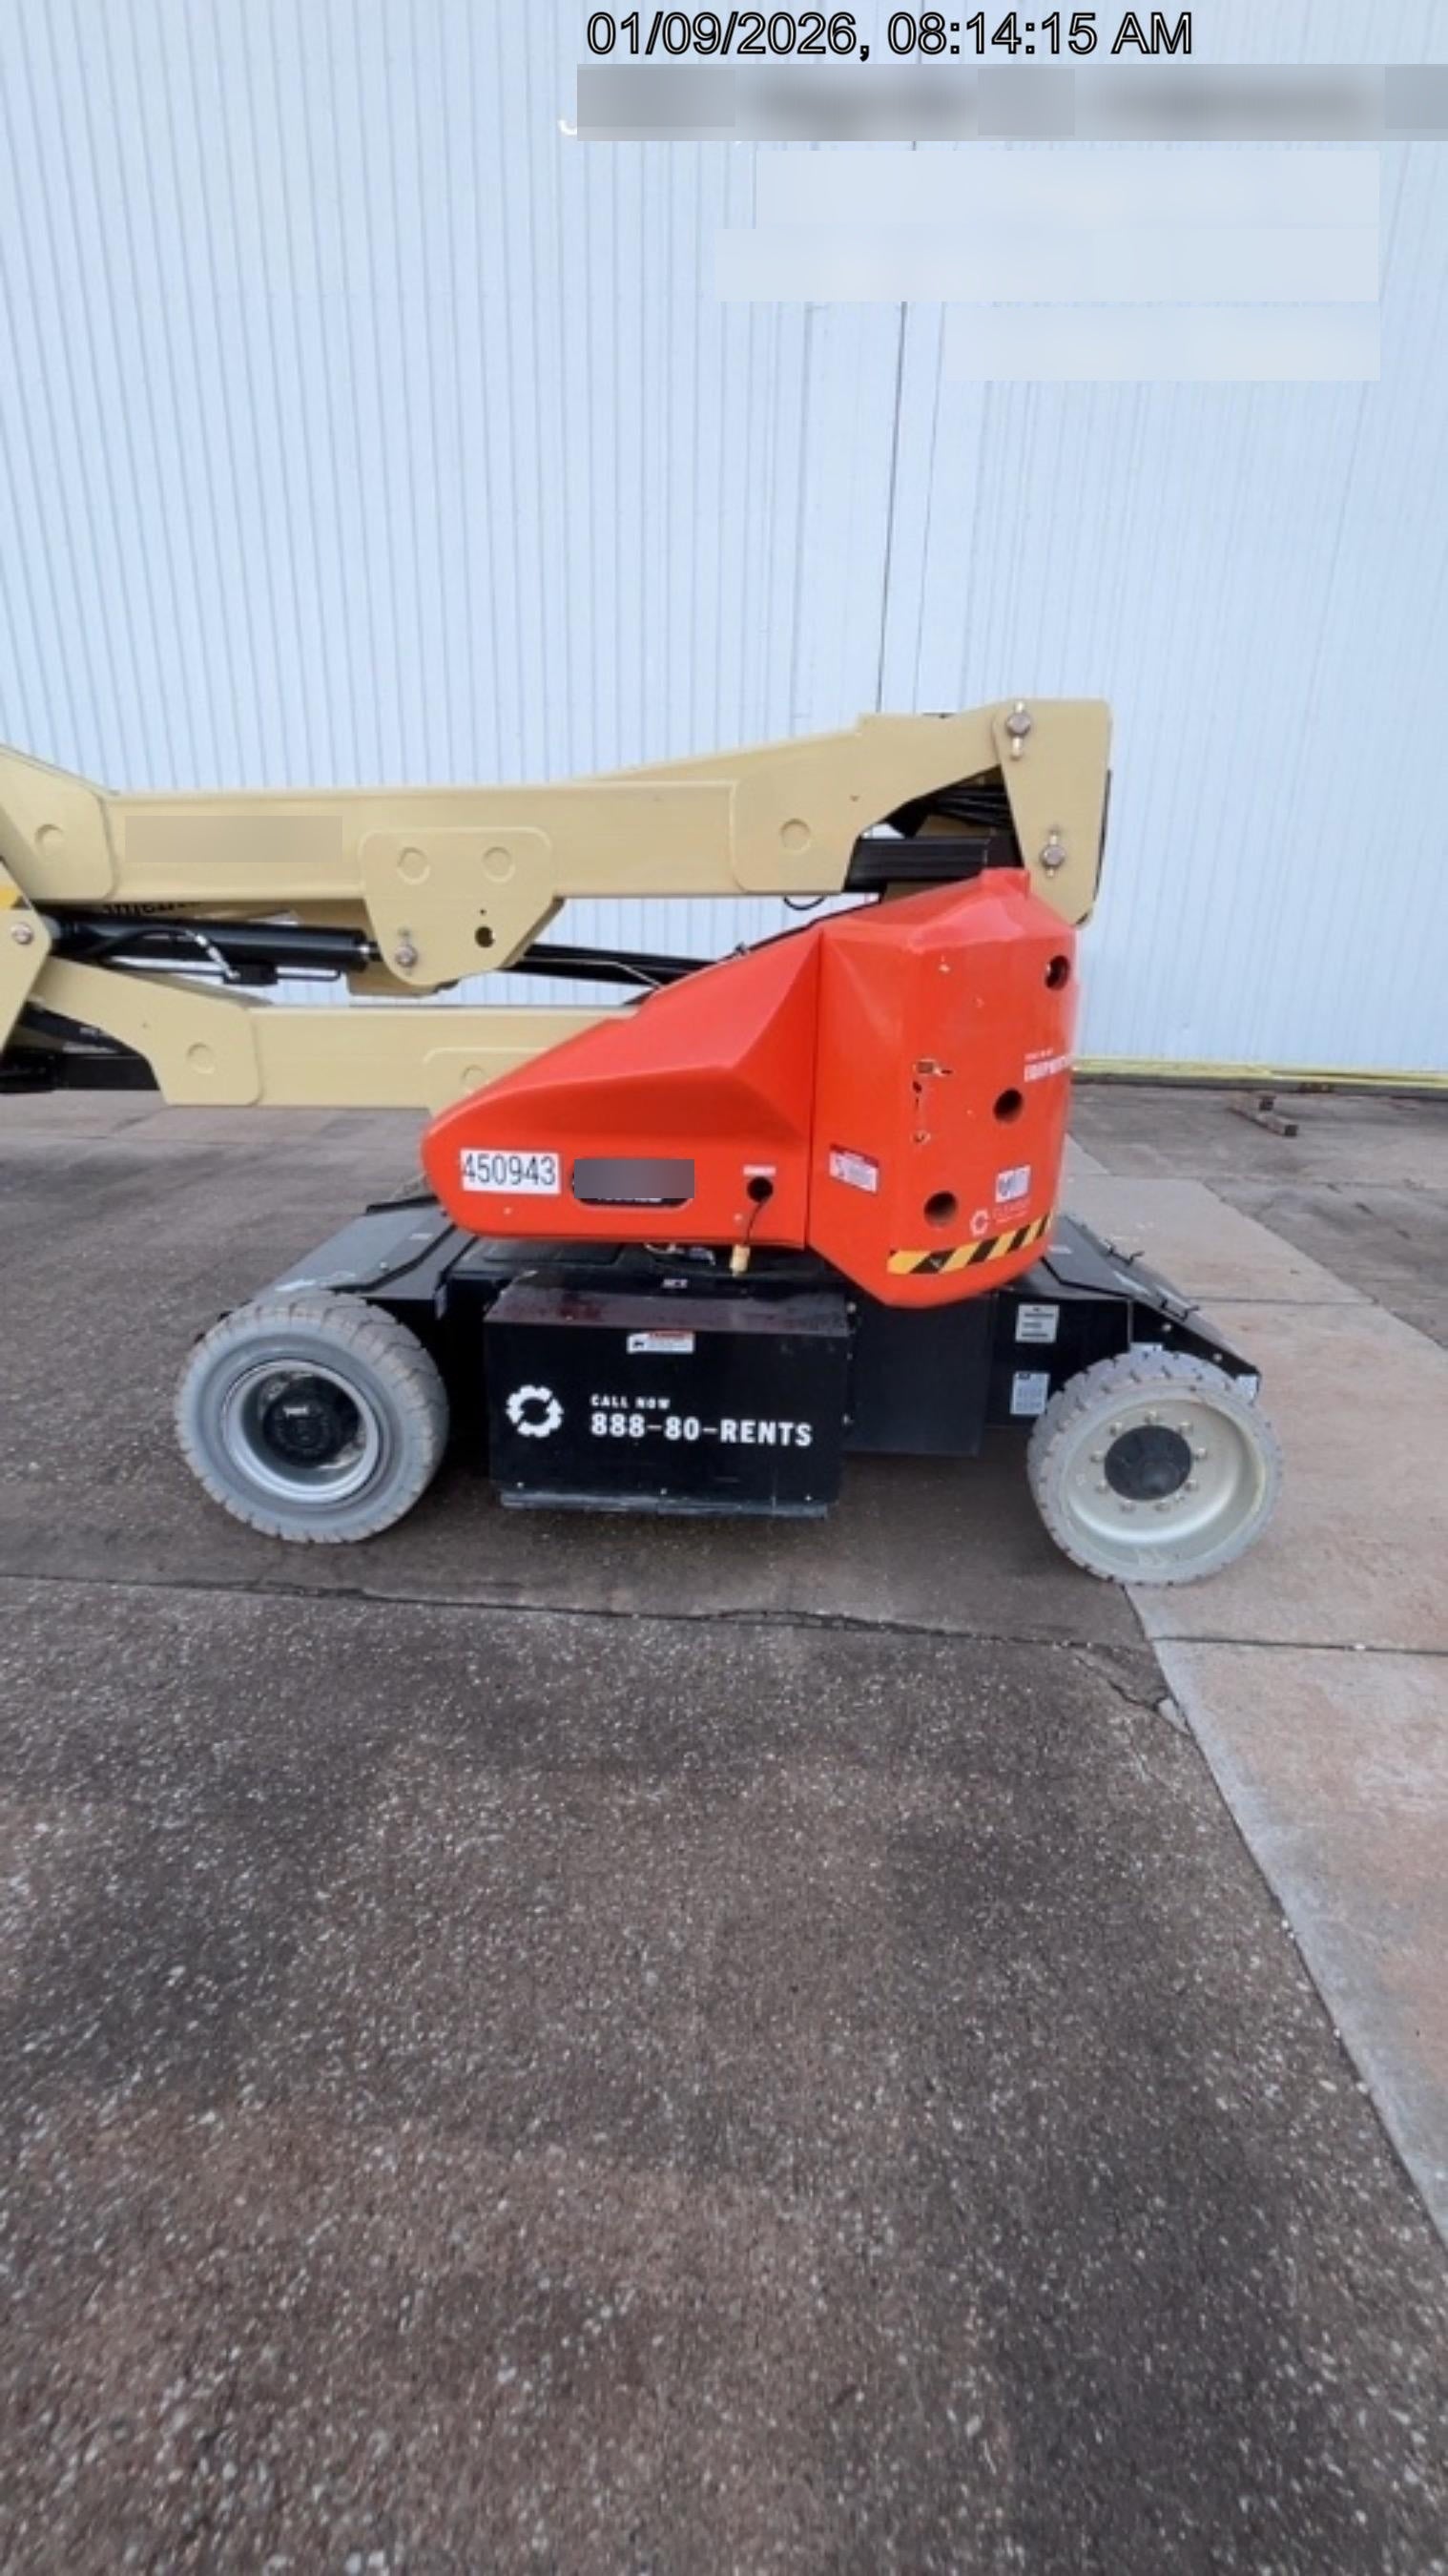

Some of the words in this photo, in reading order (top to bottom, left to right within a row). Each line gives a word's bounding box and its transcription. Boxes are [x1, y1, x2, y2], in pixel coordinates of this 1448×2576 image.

[463, 1153, 556, 1186] 450943
[590, 1394, 629, 1409] CALL
[635, 1397, 671, 1409] NOW
[590, 1412, 813, 1446] 888-80-RENTS
